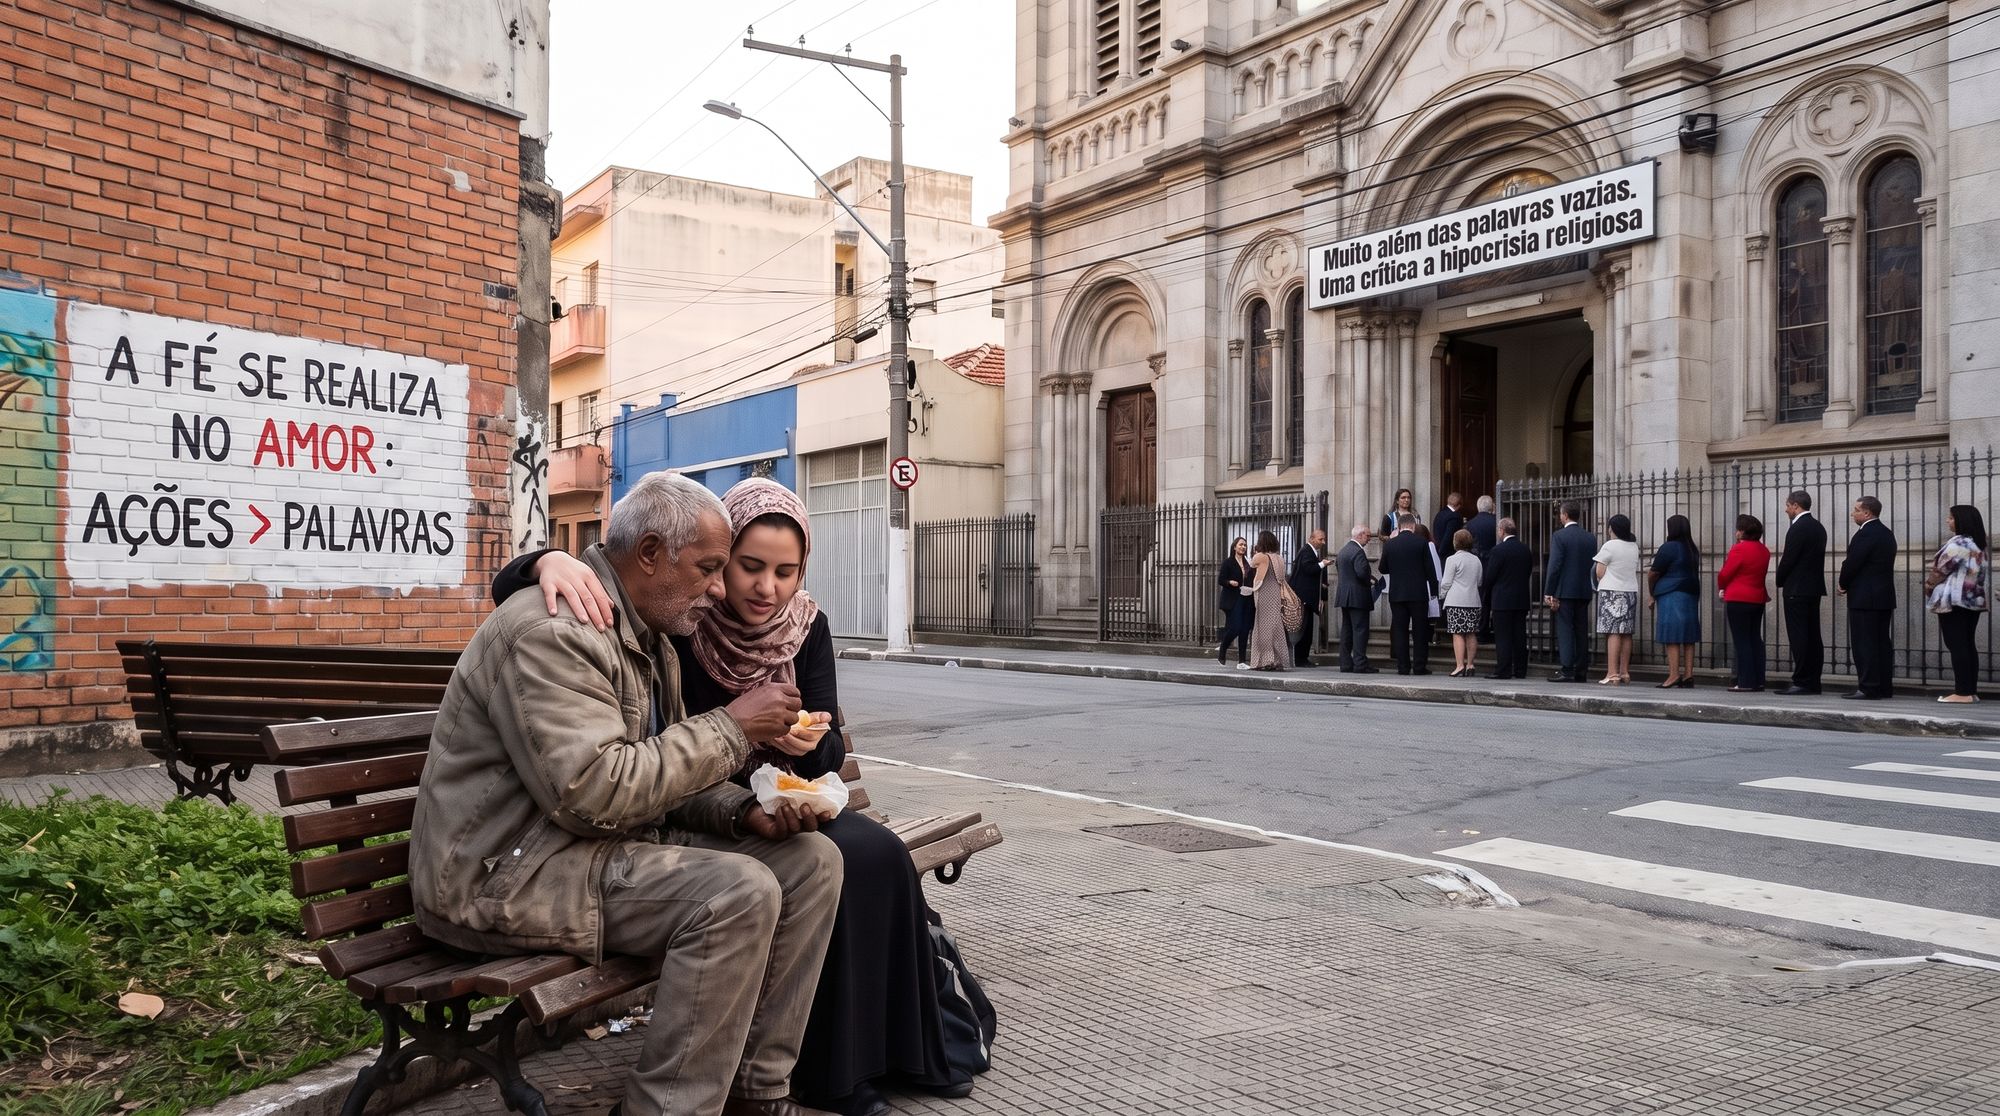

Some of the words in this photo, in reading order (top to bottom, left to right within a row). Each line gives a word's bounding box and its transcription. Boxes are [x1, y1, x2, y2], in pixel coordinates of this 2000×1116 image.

[1319, 274, 1355, 299] Uma
[1360, 259, 1418, 290] crítica
[1423, 256, 1435, 277] a
[1440, 229, 1540, 274] hipocrisia
[1546, 208, 1643, 250] religiosa
[1324, 242, 1372, 272] Muito
[1377, 229, 1422, 259] além
[1427, 221, 1462, 248] das
[1467, 198, 1554, 243] palavras
[1560, 178, 1637, 215] vazias.
[105, 335, 140, 385] A
[163, 331, 218, 393] FÉ
[237, 352, 288, 401] SE
[304, 358, 442, 421] REALIZA
[171, 412, 231, 463] NO
[898, 465, 910, 482] E
[82, 482, 234, 557] AÇÕES
[283, 501, 454, 556] PALAVRAS
